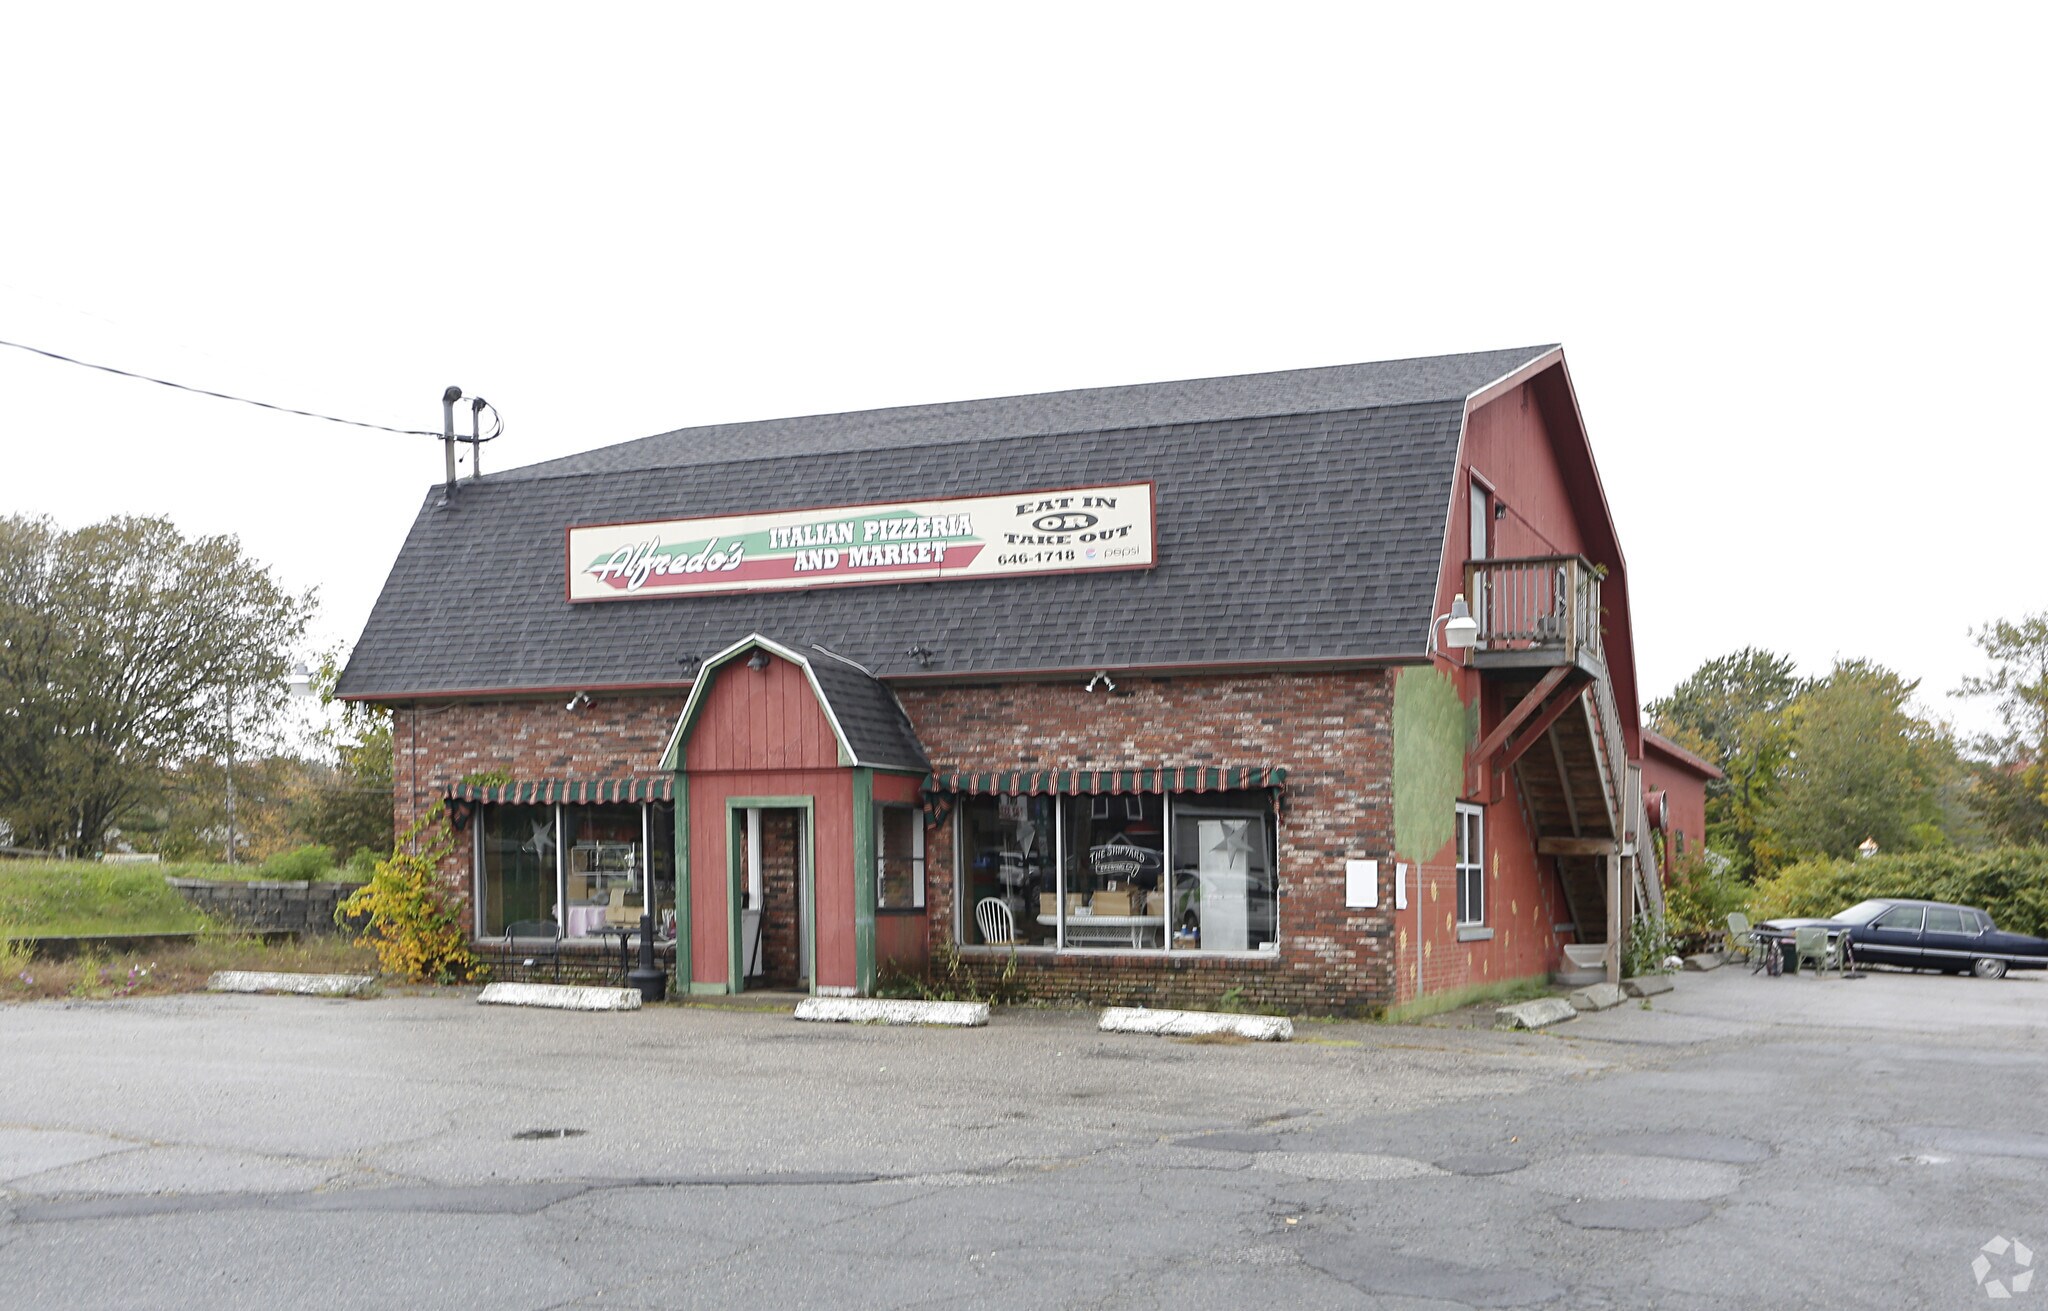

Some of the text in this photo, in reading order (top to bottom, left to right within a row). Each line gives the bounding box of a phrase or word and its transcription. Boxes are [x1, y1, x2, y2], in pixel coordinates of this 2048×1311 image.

[1015, 496, 1118, 516] EAT IN
[768, 513, 974, 549] ITALIAN PIZZERIA
[1038, 515, 1089, 529] OR
[1003, 524, 1133, 545] TAKE OUT
[793, 541, 948, 572] AND MARKET
[997, 549, 1076, 565] 646-1718
[1104, 545, 1140, 559] pepsi
[581, 535, 745, 592] Alfredo's
[1089, 849, 1106, 864] THE
